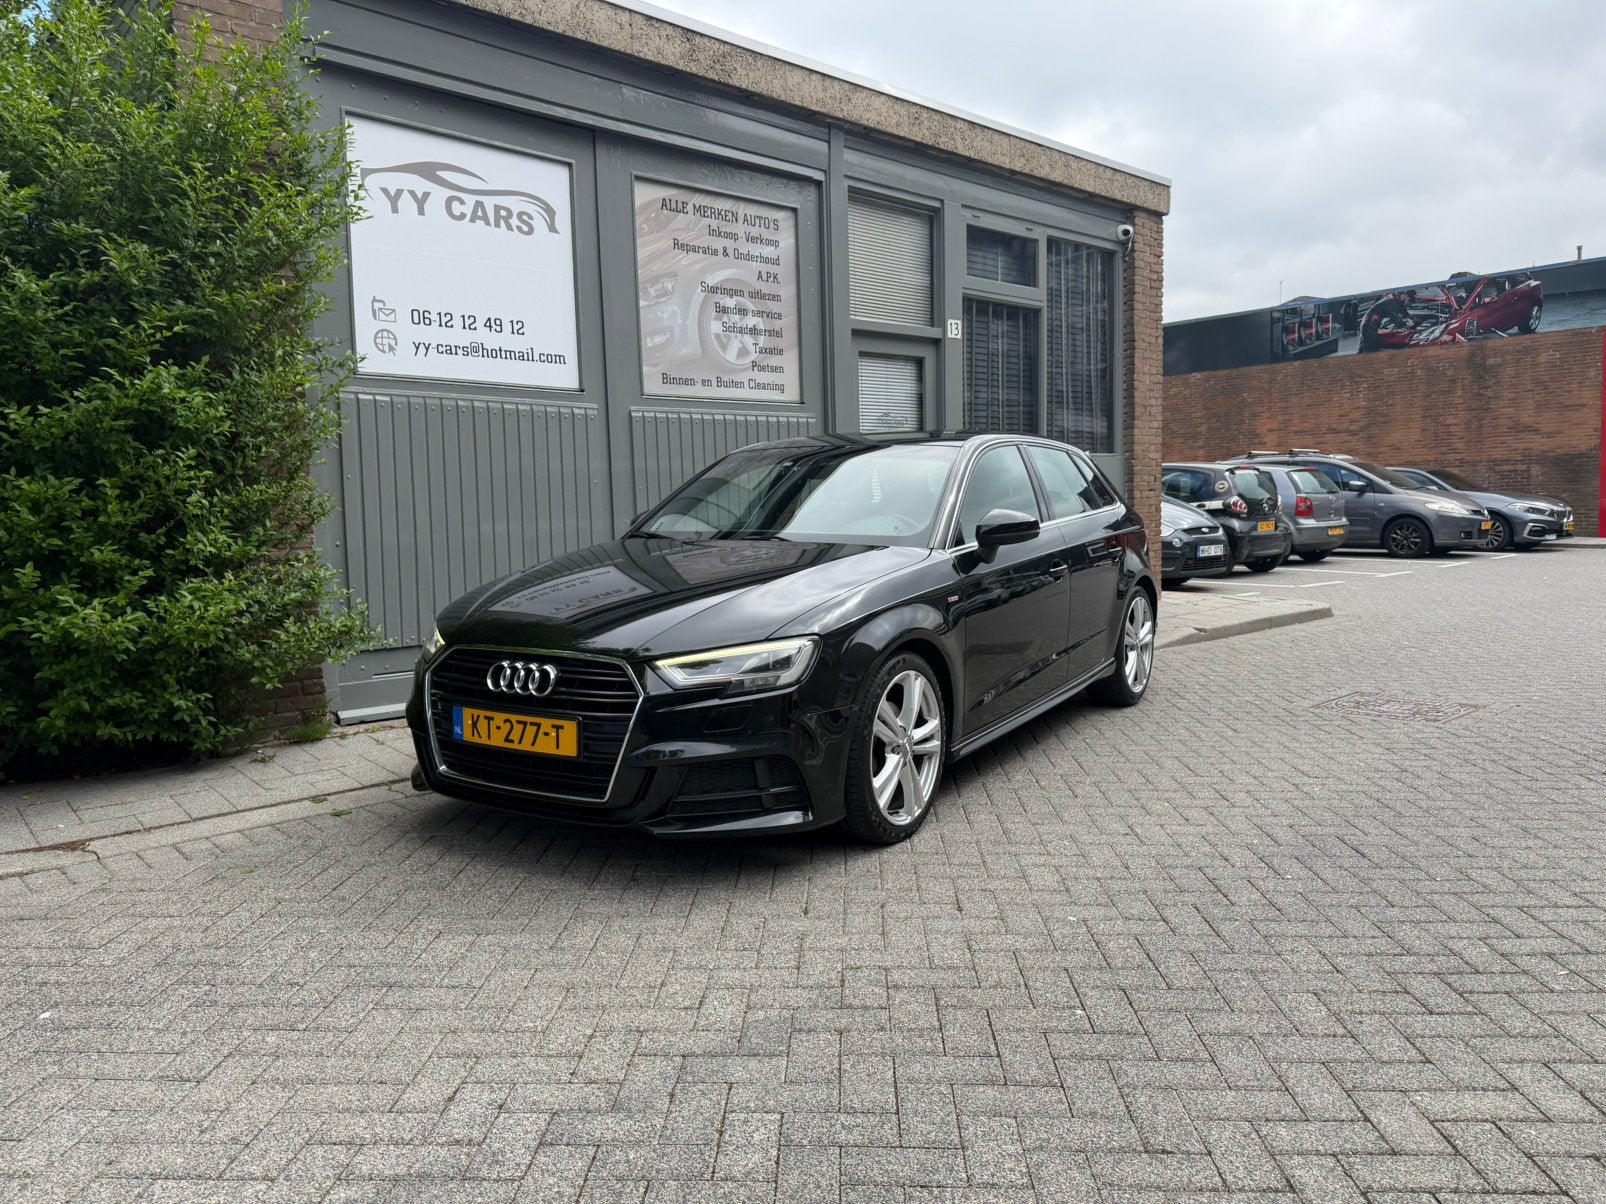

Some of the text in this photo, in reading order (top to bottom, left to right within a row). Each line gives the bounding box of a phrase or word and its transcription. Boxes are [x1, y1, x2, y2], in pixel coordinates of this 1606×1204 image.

[378, 186, 535, 236] YY CARS
[660, 197, 779, 231] ALLE MERKEN AUTO'S
[673, 238, 781, 266] Reparatie & Onderhoud
[757, 270, 781, 285] A.P.K.
[700, 281, 782, 303] Storingen uitlezen
[714, 301, 783, 320] Banden service
[410, 308, 526, 336] 06-12 12 49 12
[721, 321, 783, 338] Schadeherstel
[949, 322, 960, 336] 13
[412, 341, 567, 365] yy-cars@hotmail.com
[752, 342, 784, 356] Taxatie
[751, 360, 785, 374] Poetsen
[661, 372, 785, 394] Binnen- en Buiten Cleaning
[470, 713, 565, 750] KT-277-T
